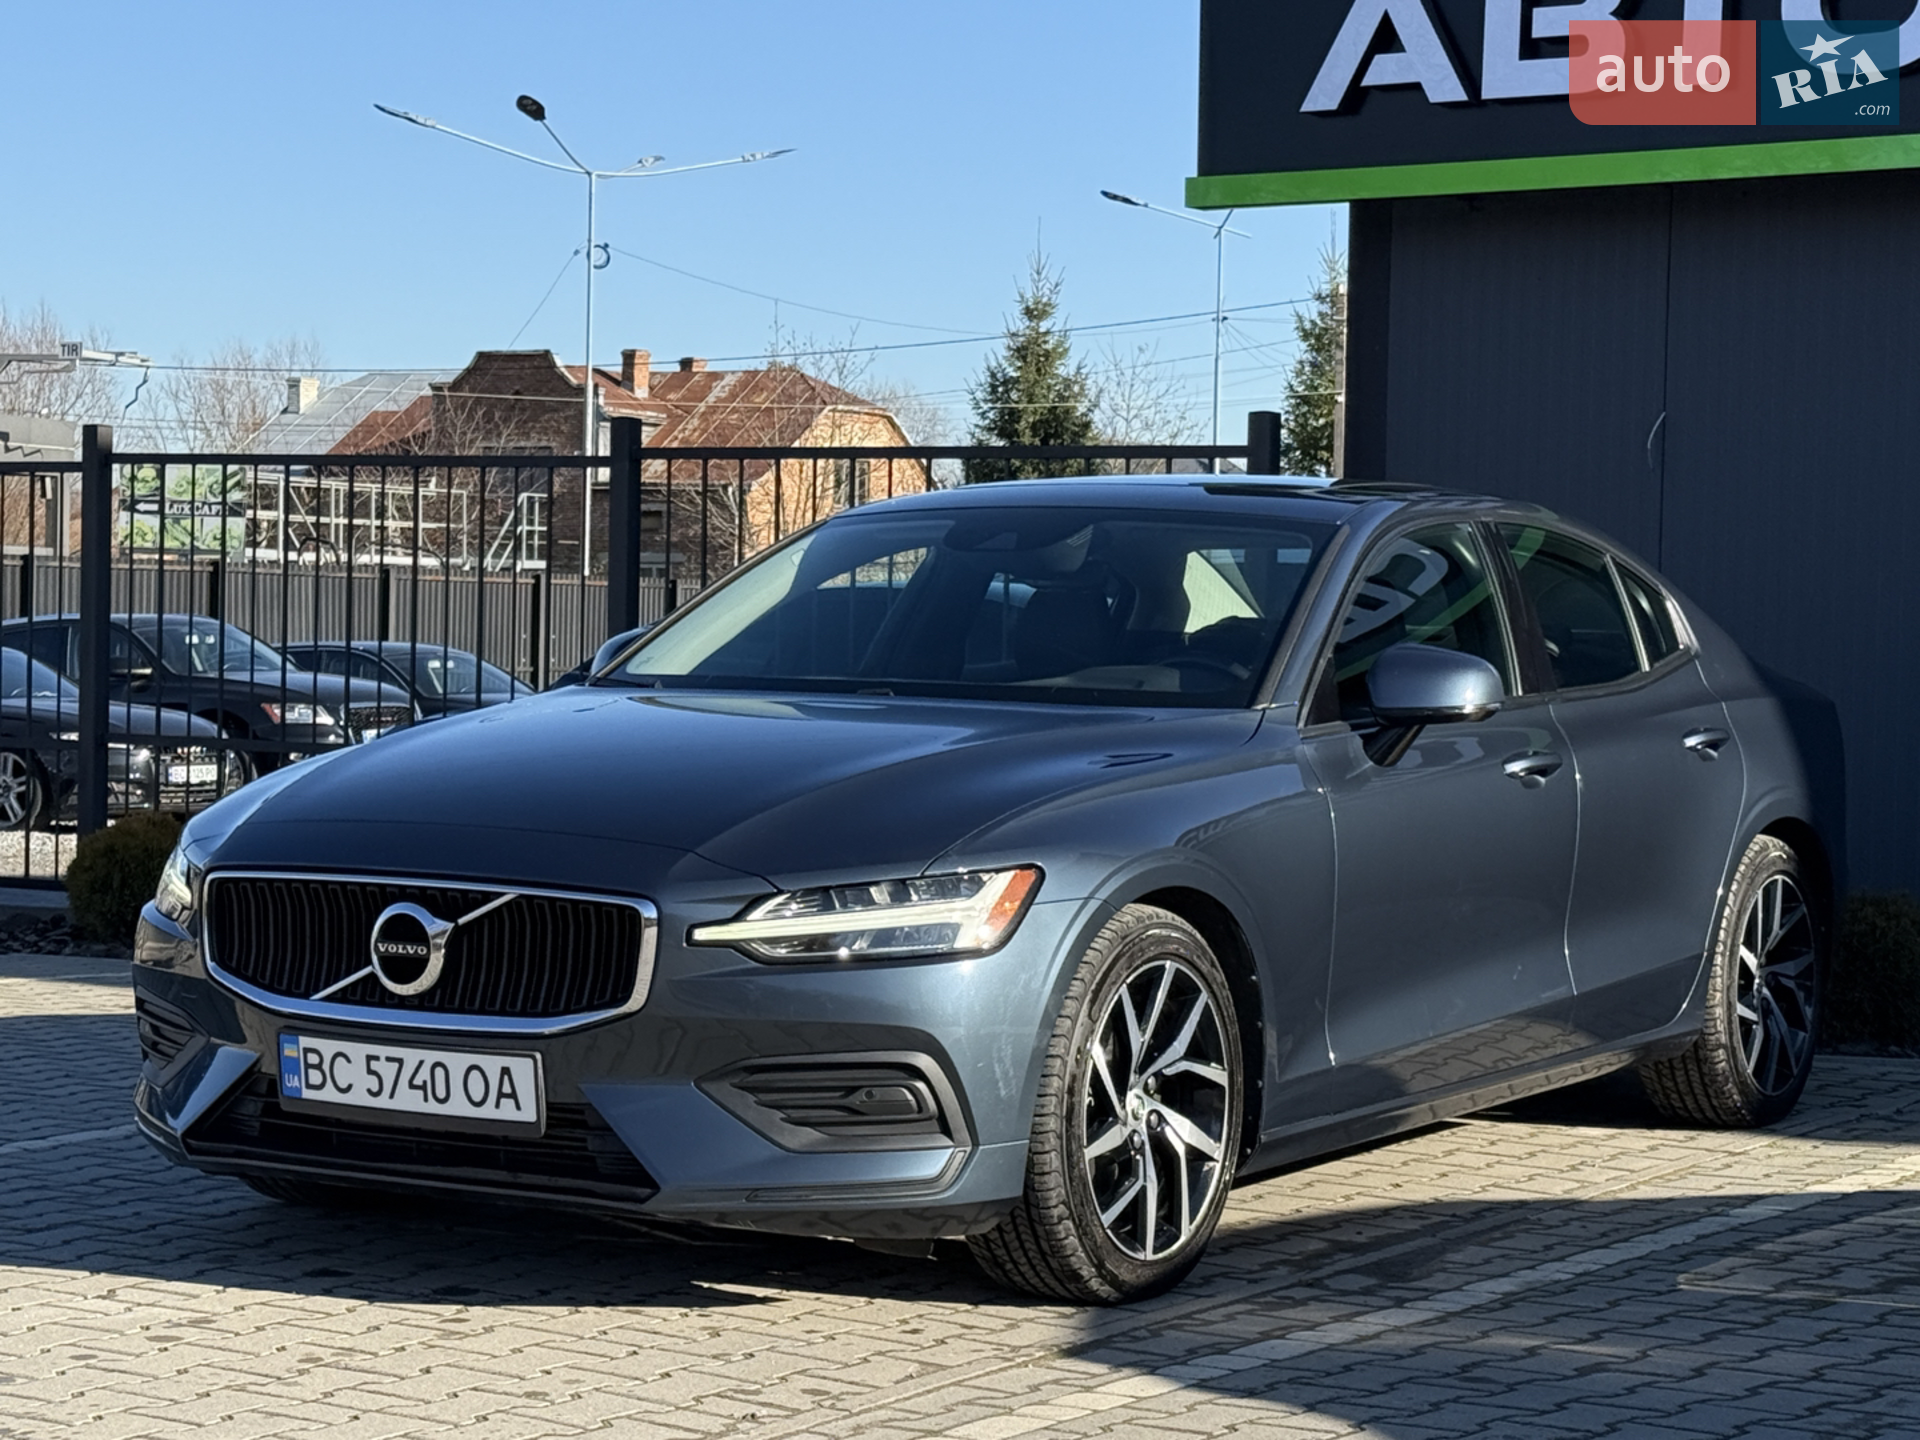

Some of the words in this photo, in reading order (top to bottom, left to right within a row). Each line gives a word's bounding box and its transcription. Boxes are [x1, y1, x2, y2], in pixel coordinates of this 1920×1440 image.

[60, 343, 79, 357] TIR
[377, 942, 428, 955] VOLVO
[284, 1072, 300, 1088] UA
[302, 1046, 354, 1094] BC
[364, 1053, 451, 1105] 5740
[462, 1063, 522, 1111] OA
